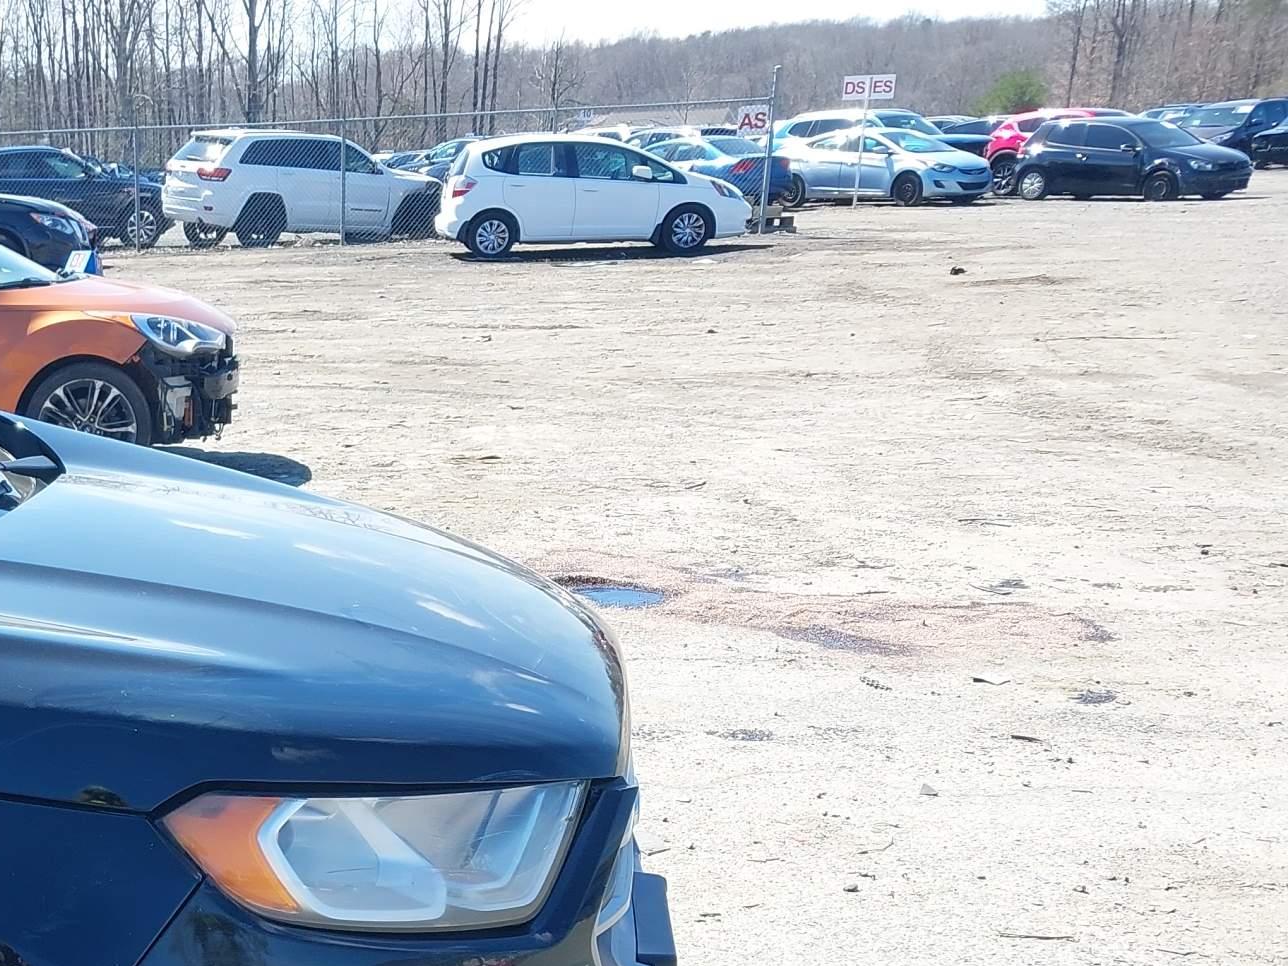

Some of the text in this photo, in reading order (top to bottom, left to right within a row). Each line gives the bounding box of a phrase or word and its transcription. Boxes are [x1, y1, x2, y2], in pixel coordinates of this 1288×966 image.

[845, 81, 866, 95] DS
[873, 80, 894, 94] ES
[738, 112, 768, 130] AS
